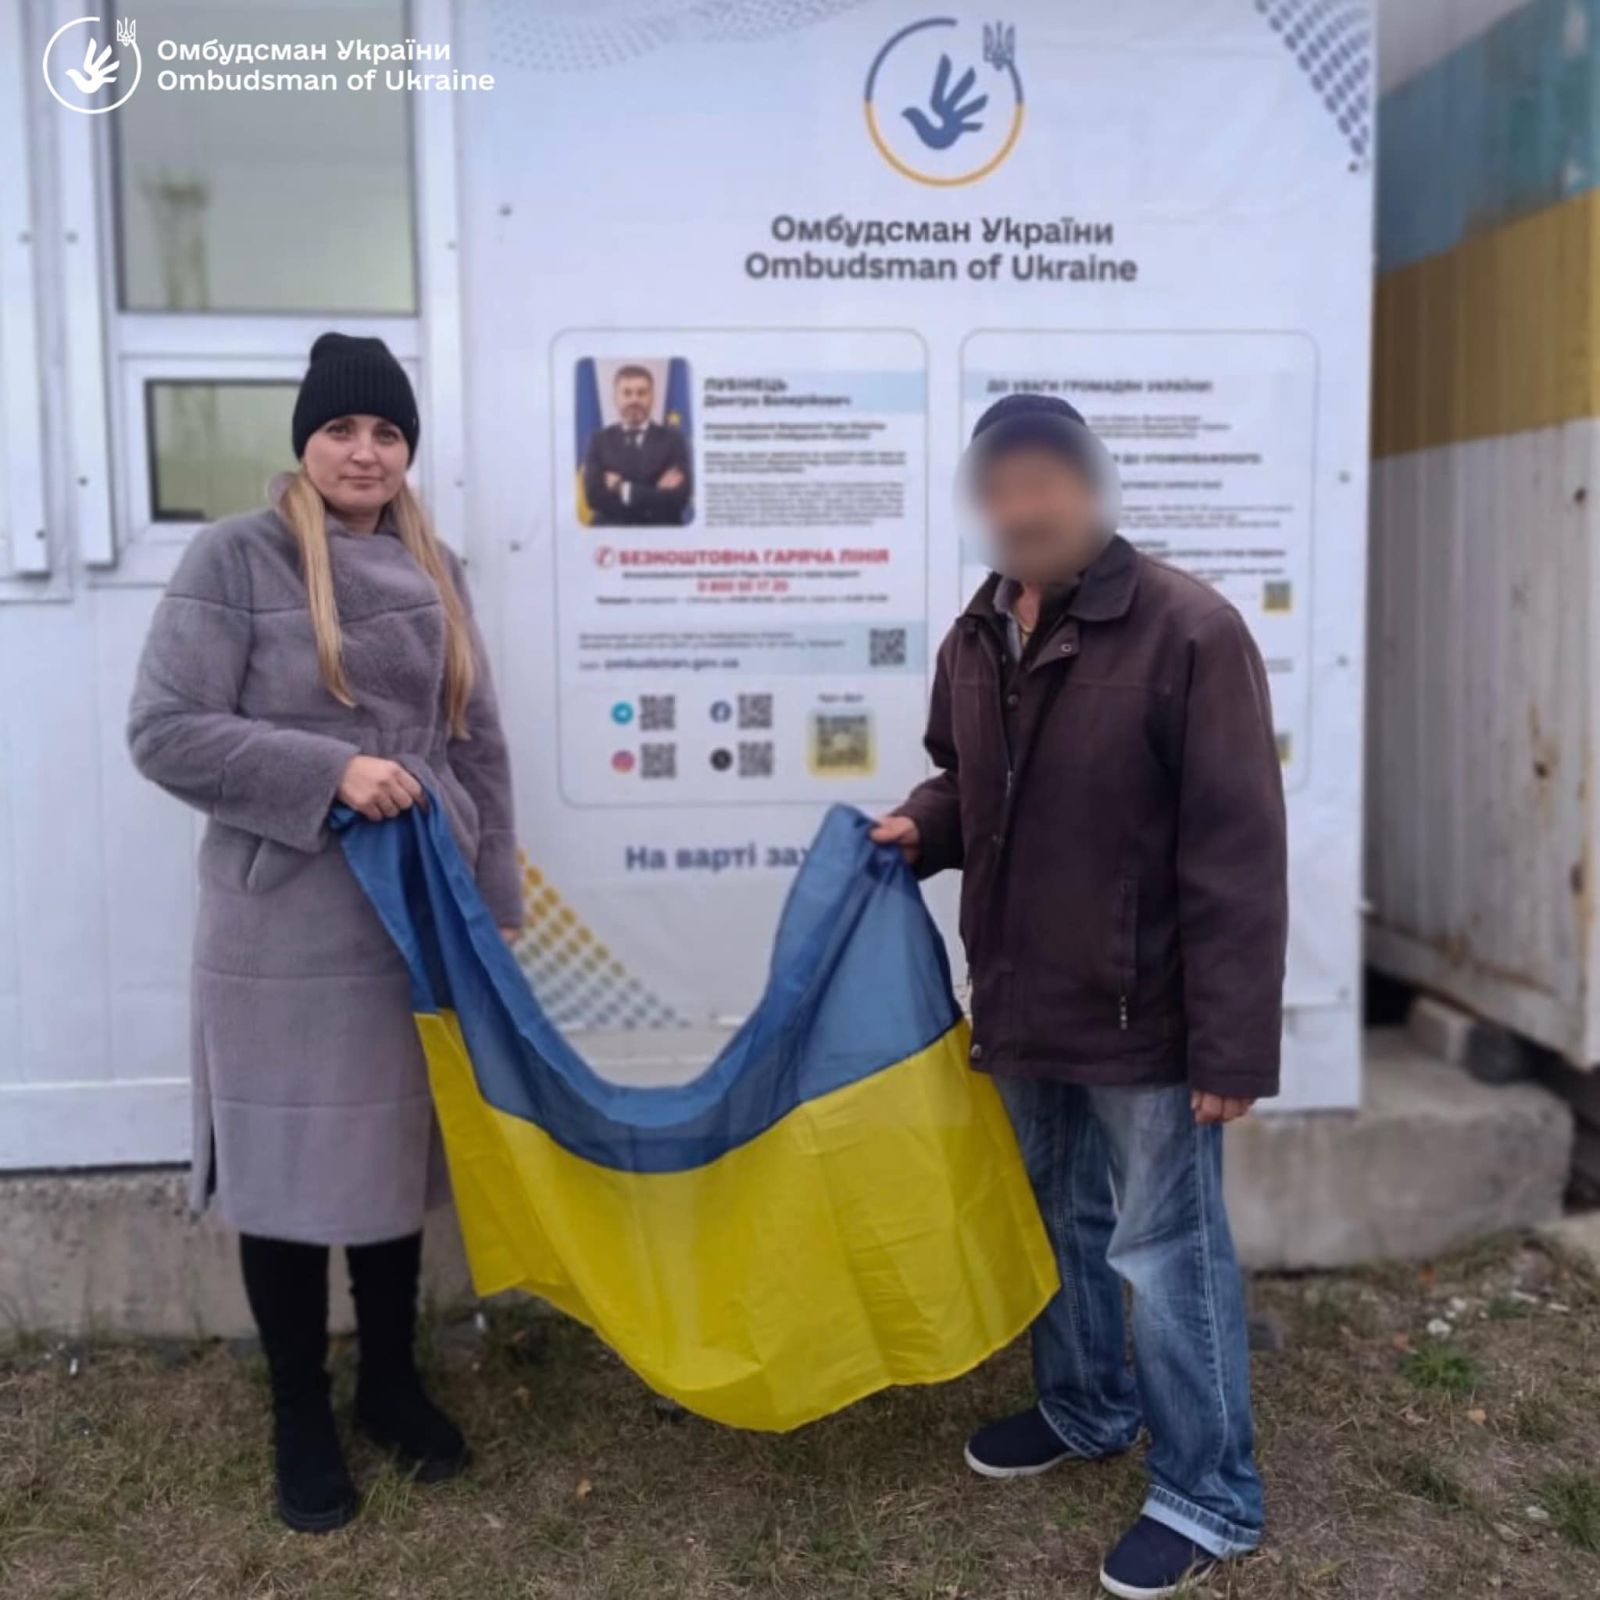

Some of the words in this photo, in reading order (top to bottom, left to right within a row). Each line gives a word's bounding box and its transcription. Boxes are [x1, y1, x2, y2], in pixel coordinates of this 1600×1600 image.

[771, 215, 970, 247] Омбудсман
[982, 217, 1114, 249] України
[744, 252, 957, 281] Ombudsman
[967, 253, 1001, 281] of
[1011, 254, 1138, 282] Ukraine
[620, 549, 759, 566] БЕЗКОШТОВНА
[763, 549, 835, 565] ГАРЯЧА
[840, 548, 889, 564] ЛІНІЯ
[625, 845, 667, 871] На
[676, 843, 757, 873] варті
